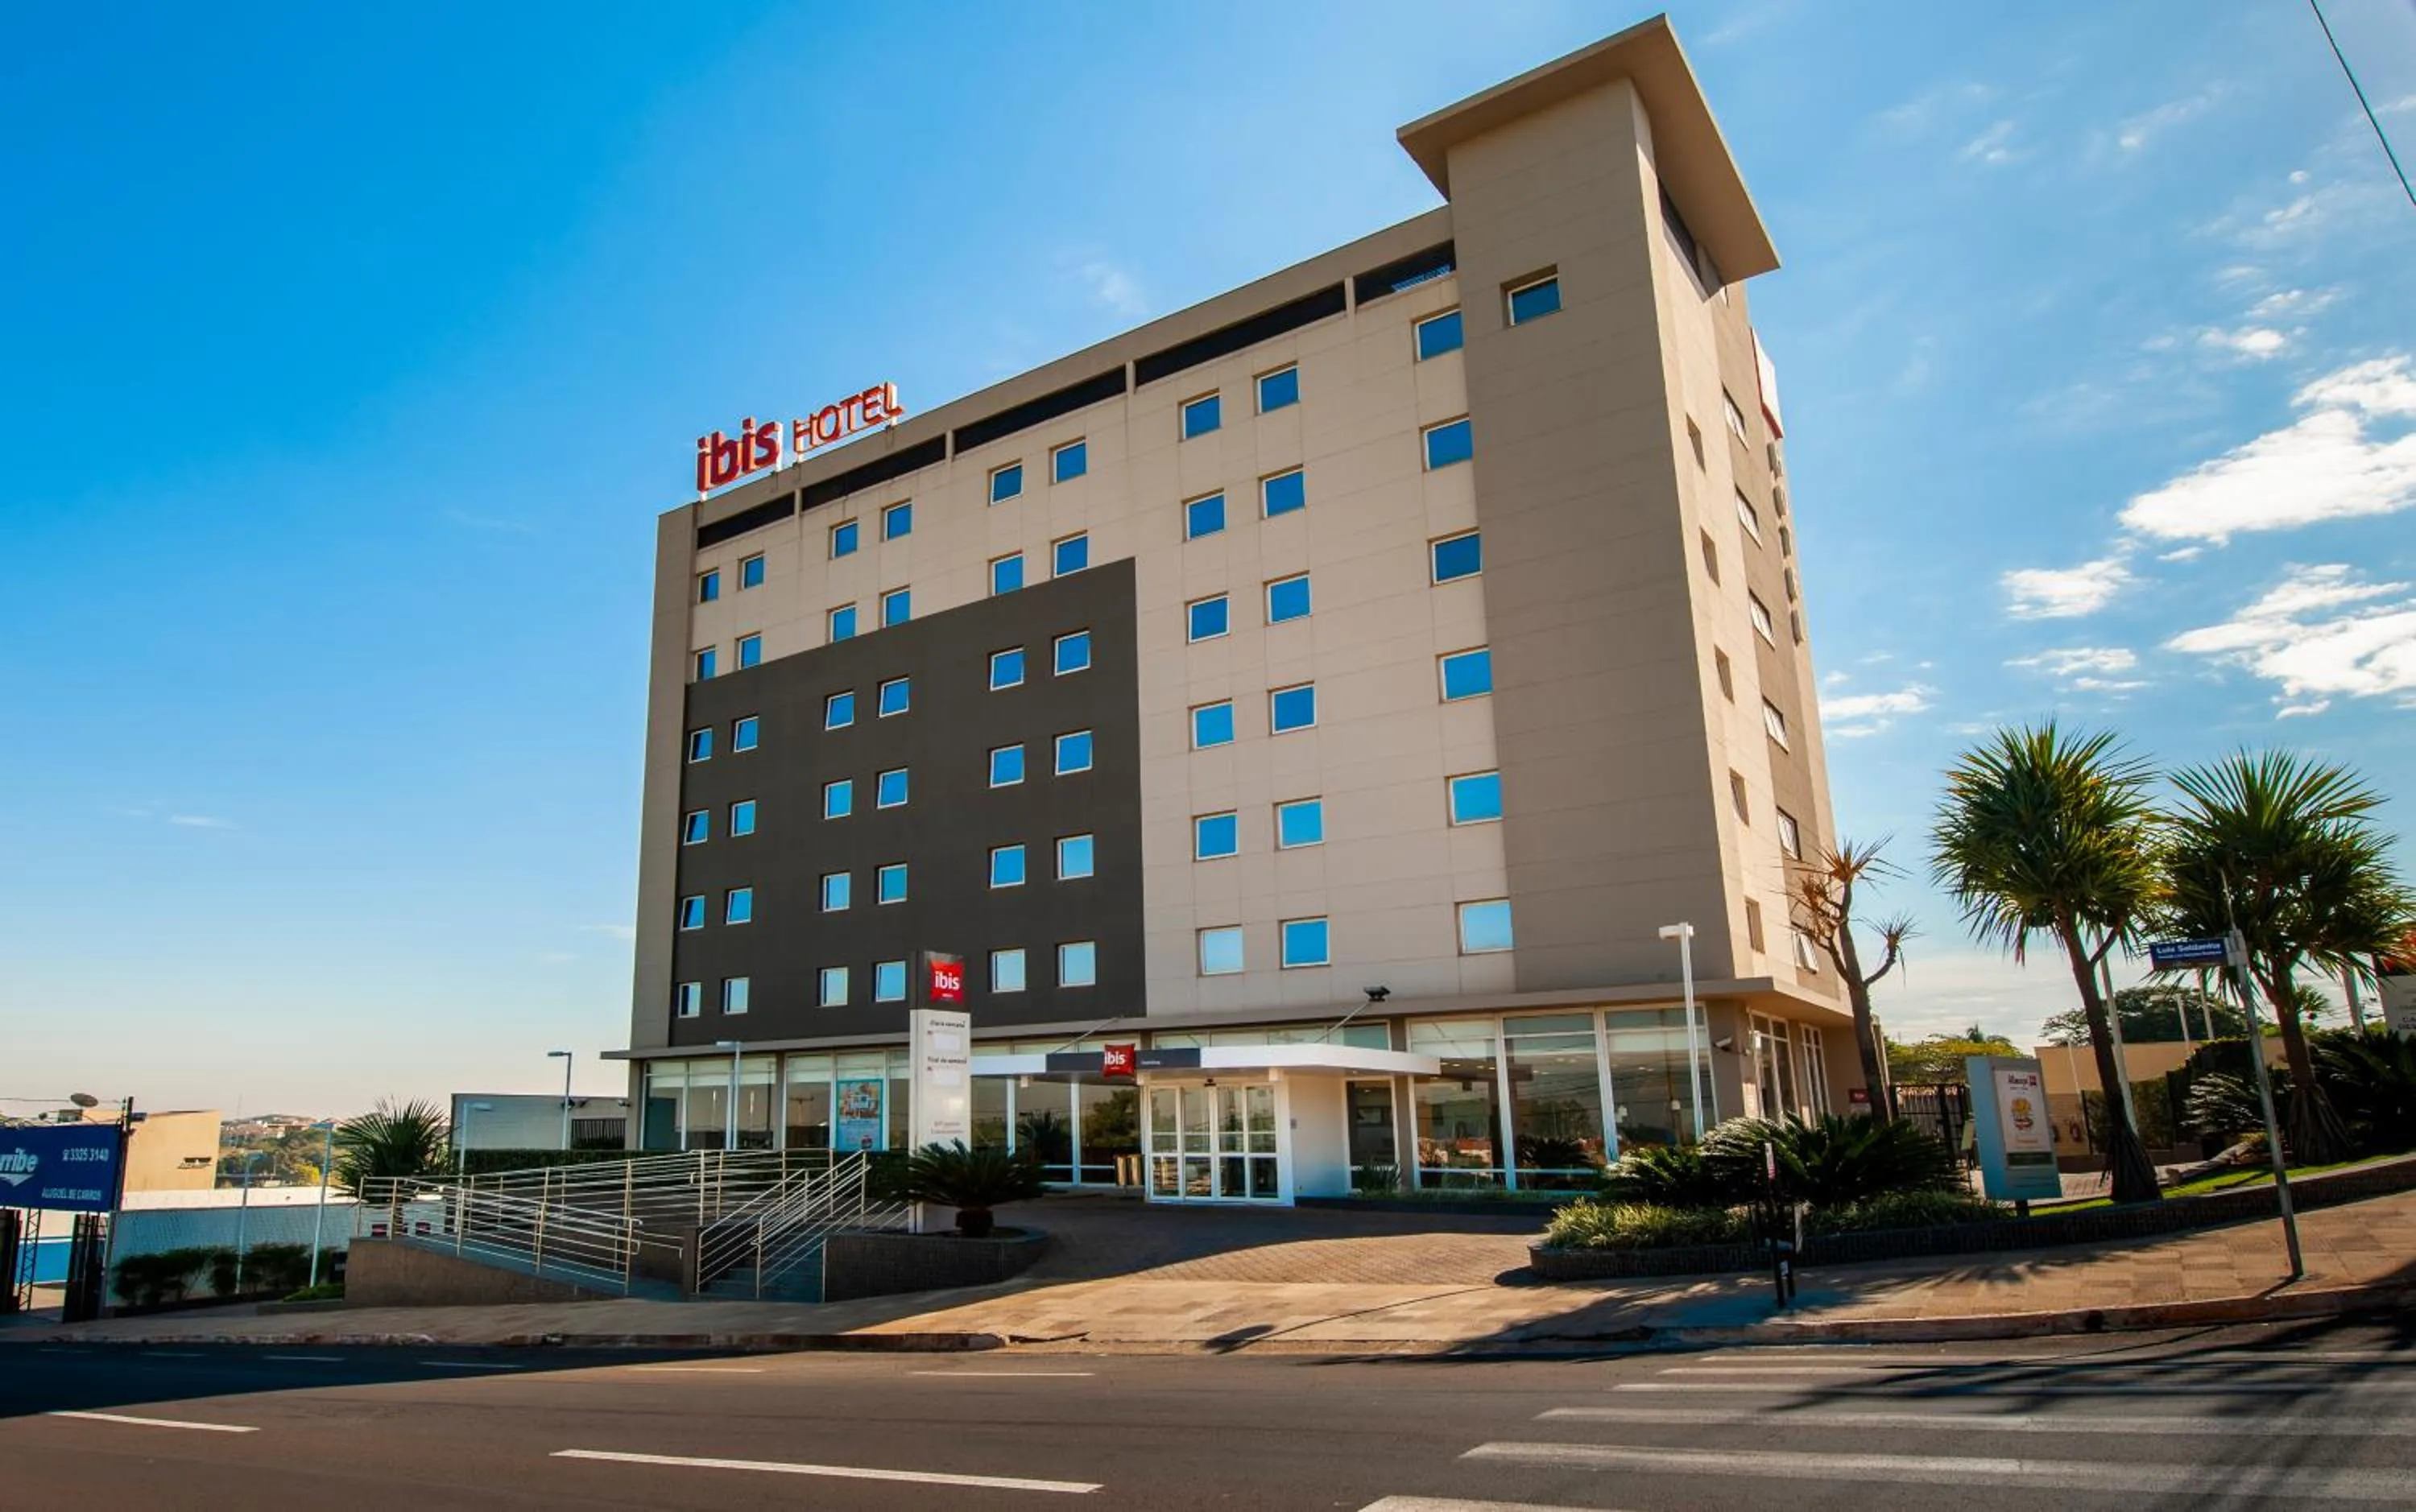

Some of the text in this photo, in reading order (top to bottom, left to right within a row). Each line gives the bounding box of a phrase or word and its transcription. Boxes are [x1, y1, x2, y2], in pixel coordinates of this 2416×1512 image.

[697, 382, 904, 493] ibis HOTEL
[934, 970, 961, 991] ibis
[1104, 1051, 1126, 1066] ibis
